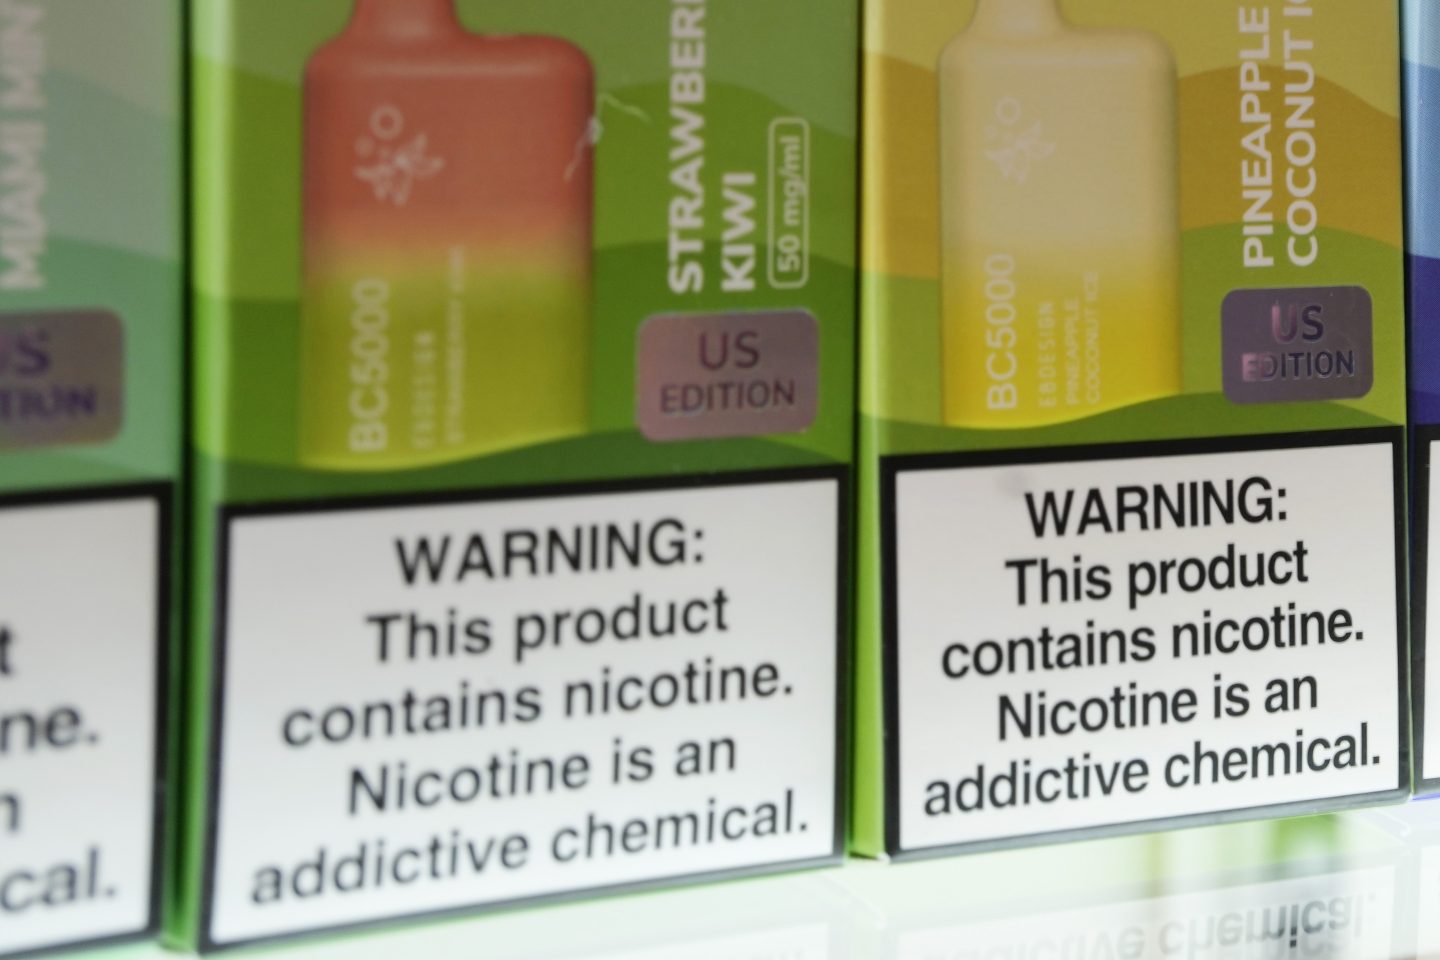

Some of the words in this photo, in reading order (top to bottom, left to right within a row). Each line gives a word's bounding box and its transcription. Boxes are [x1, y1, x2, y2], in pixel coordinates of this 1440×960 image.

[1239, 6, 1275, 268] PINEAPPLE
[1282, 29, 1319, 267] COCONUT
[779, 136, 807, 227] mg/ml
[721, 173, 756, 292] KIWI
[778, 234, 798, 273] 50
[698, 331, 760, 370] US
[985, 253, 1018, 411] BC5000
[1271, 301, 1325, 343] US
[349, 277, 389, 452] BC5000
[660, 379, 795, 414] EDITION
[1241, 350, 1356, 383] EDITION
[1025, 476, 1288, 538] WARNING:
[395, 519, 705, 586] WARNING:
[1005, 556, 1112, 606] This
[1128, 540, 1309, 610] product
[366, 609, 492, 664] This
[514, 589, 729, 664] product
[941, 620, 1156, 679] contains
[1171, 602, 1365, 659] nicotine.
[282, 681, 542, 749] contains
[564, 658, 795, 718] nicotine.
[997, 682, 1198, 742] Nicotine
[1212, 674, 1250, 719] is
[1264, 674, 1318, 713] an
[347, 749, 590, 817] Nicotine
[611, 737, 654, 785] is
[674, 736, 737, 776] an
[923, 754, 1149, 817] addictive
[1163, 722, 1381, 789] chemical.
[250, 831, 529, 905] addictive
[551, 789, 809, 863] chemical.
